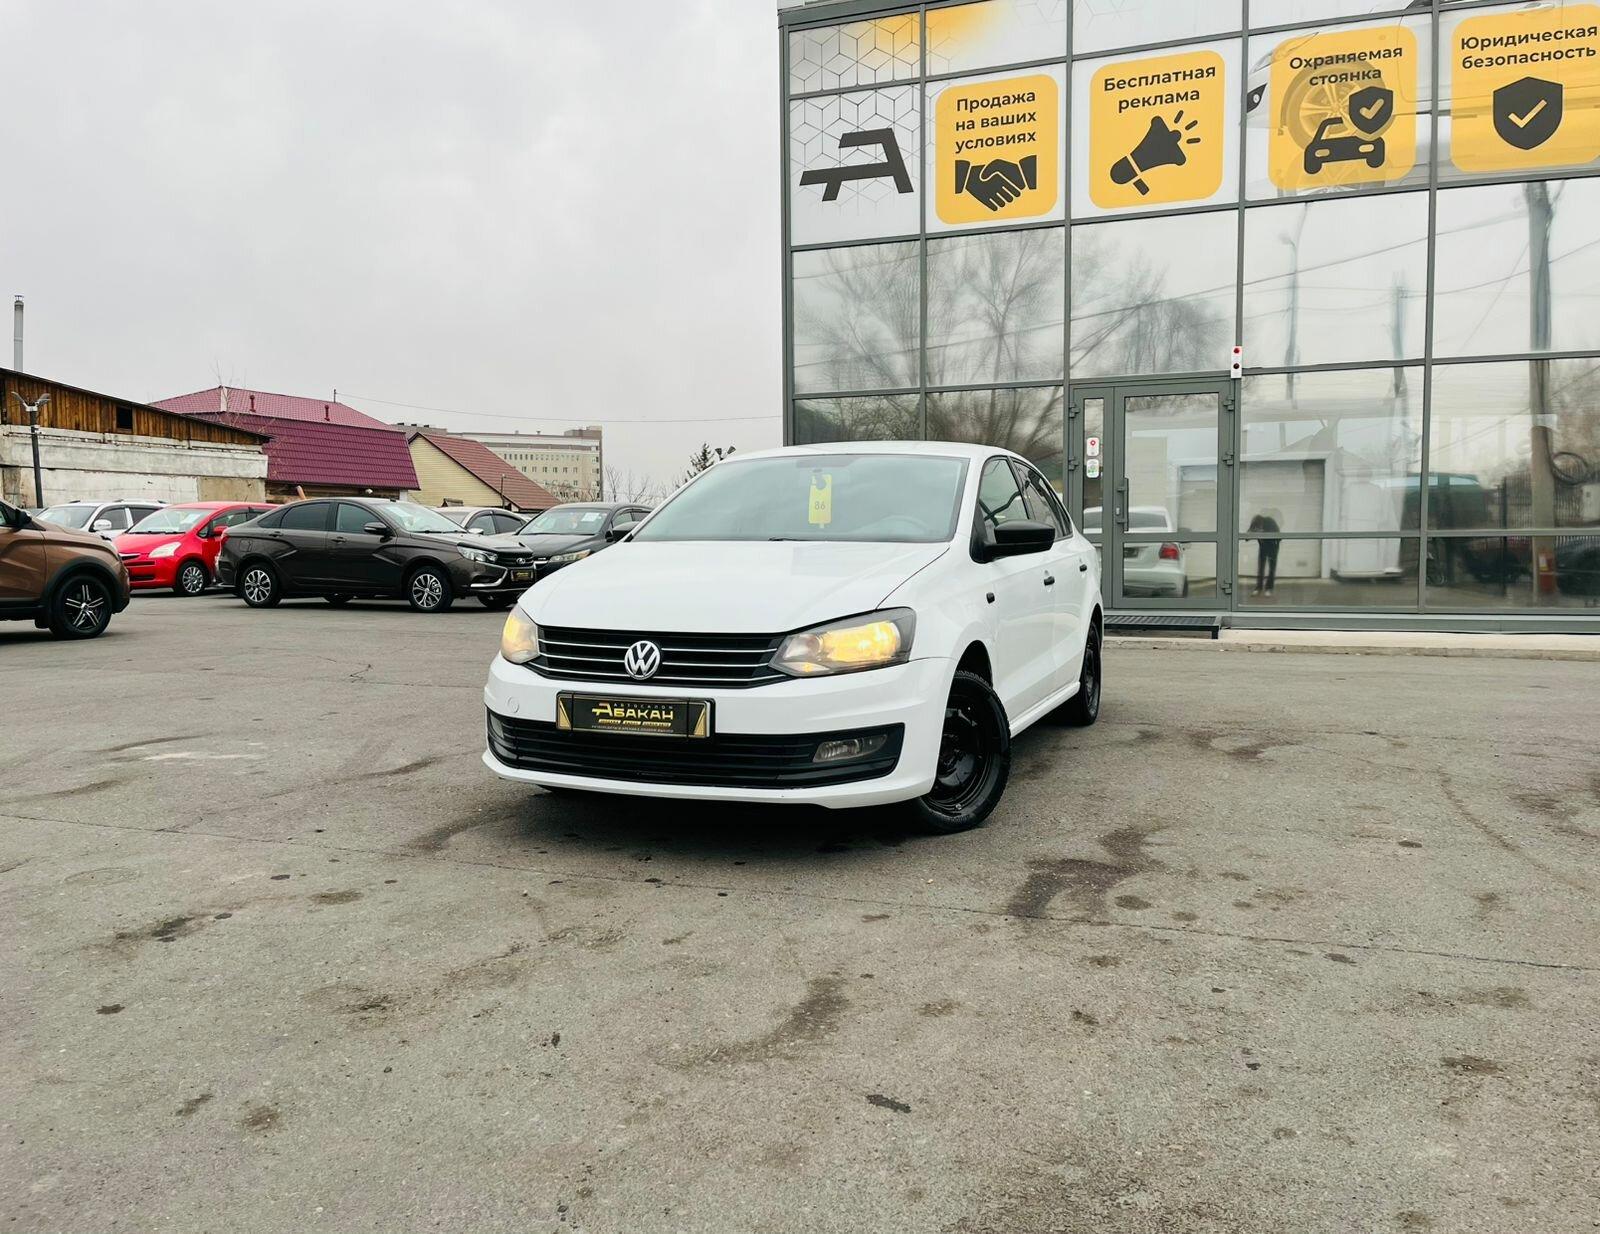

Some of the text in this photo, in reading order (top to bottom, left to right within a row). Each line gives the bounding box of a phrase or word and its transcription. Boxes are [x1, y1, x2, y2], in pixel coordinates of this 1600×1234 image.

[1461, 26, 1598, 51] Юридическая
[1289, 47, 1403, 70] Охраняемая
[1462, 47, 1597, 69] безопасность
[1104, 66, 1216, 92] Бесплатная
[1309, 68, 1382, 86] стоянка
[956, 91, 1036, 113] Продажа
[1118, 90, 1200, 113] реклама
[955, 111, 1037, 132] на ваших
[955, 131, 1036, 154] условиях
[814, 501, 826, 510] 86
